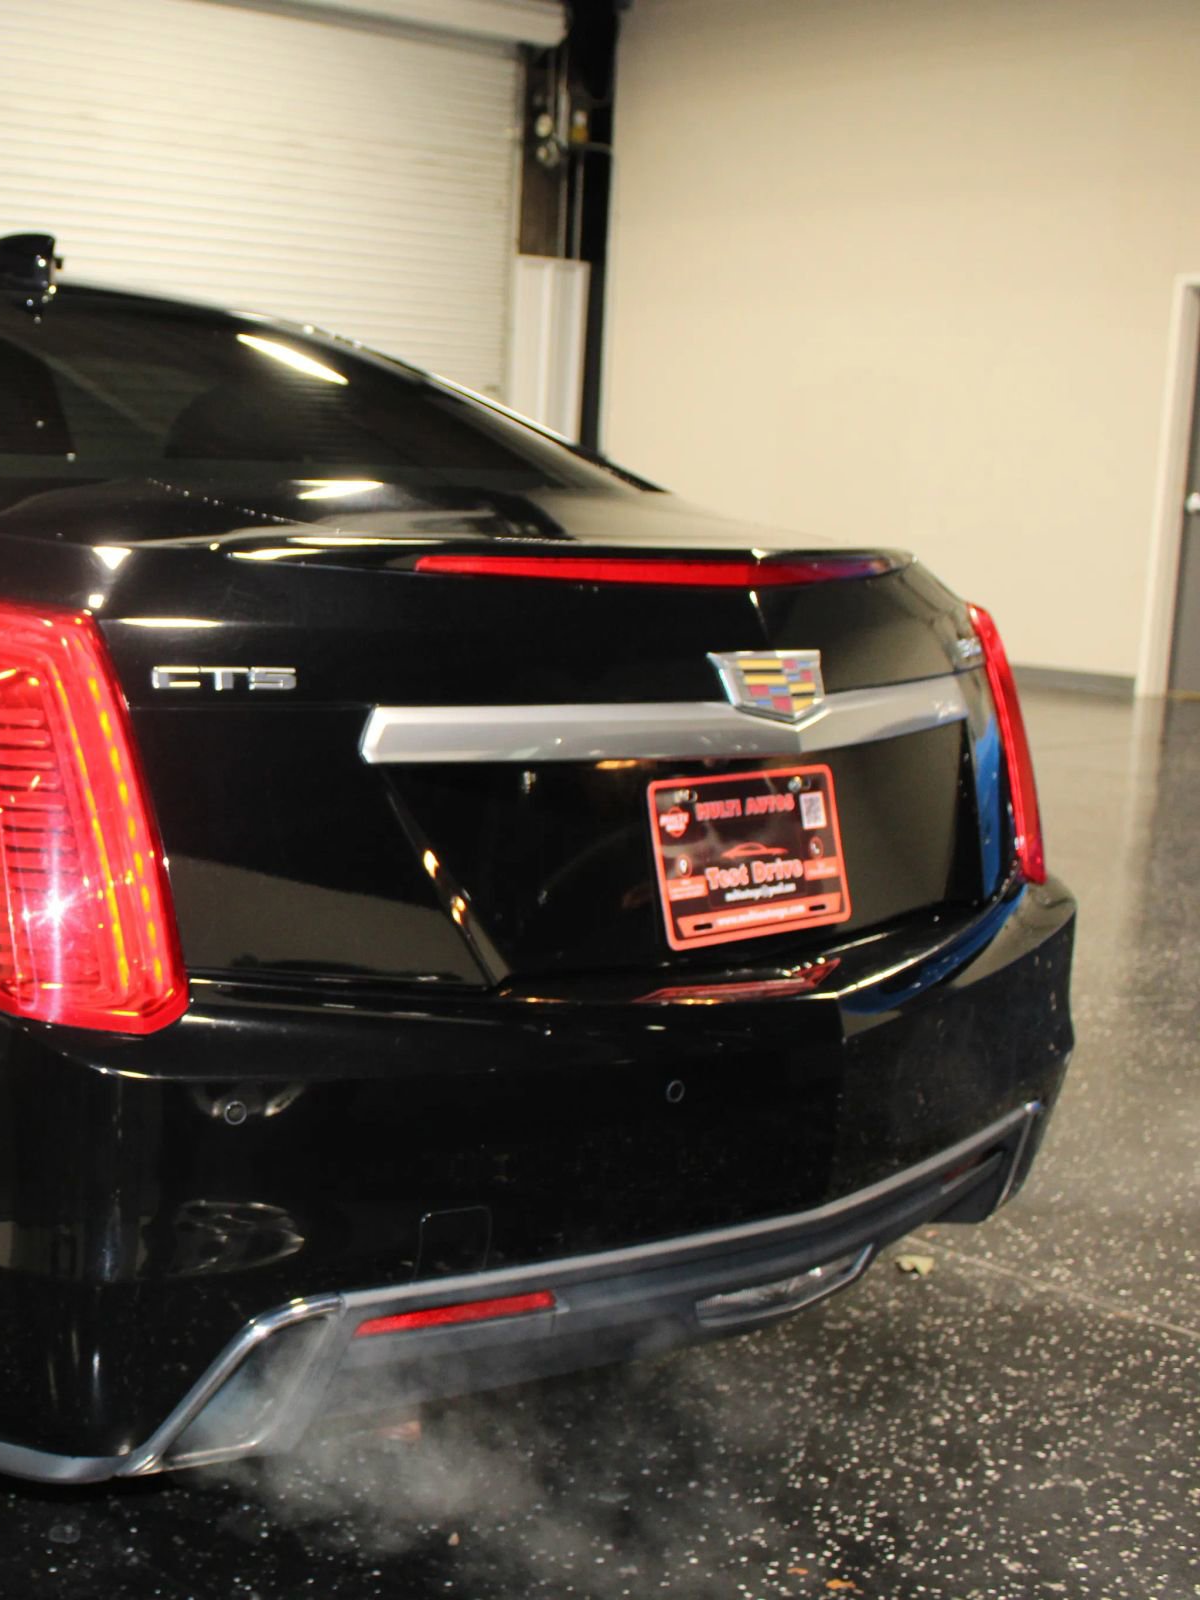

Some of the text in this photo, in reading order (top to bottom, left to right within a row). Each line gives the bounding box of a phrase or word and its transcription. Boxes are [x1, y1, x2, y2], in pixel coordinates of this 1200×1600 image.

[152, 666, 296, 690] CTS
[695, 793, 795, 821] MULTI AUTOS
[704, 863, 749, 891] Test
[750, 858, 803, 884] Drive
